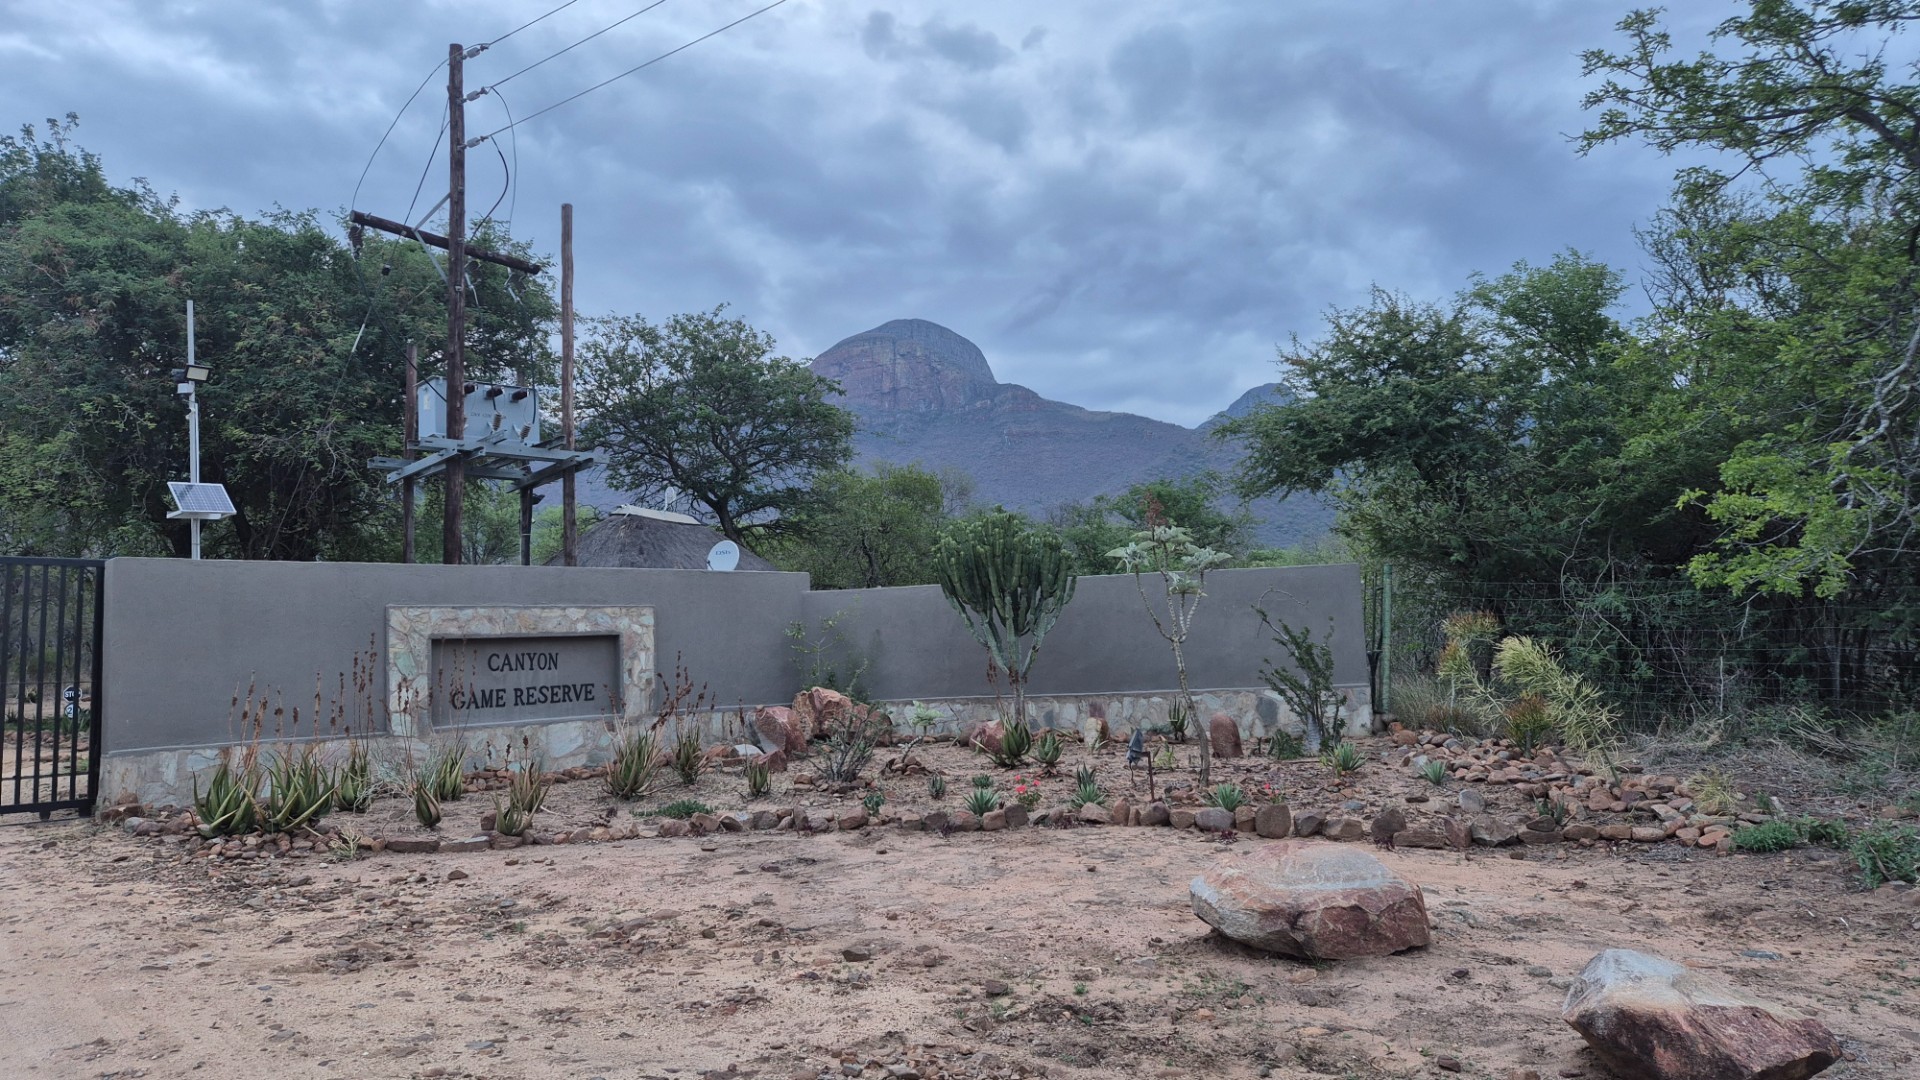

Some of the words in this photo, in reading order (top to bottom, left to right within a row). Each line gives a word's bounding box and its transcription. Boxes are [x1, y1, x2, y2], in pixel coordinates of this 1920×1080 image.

[487, 652, 560, 672] CANYON
[64, 690, 81, 698] ST
[451, 688, 507, 710] GAME
[513, 682, 596, 706] RESERVE
